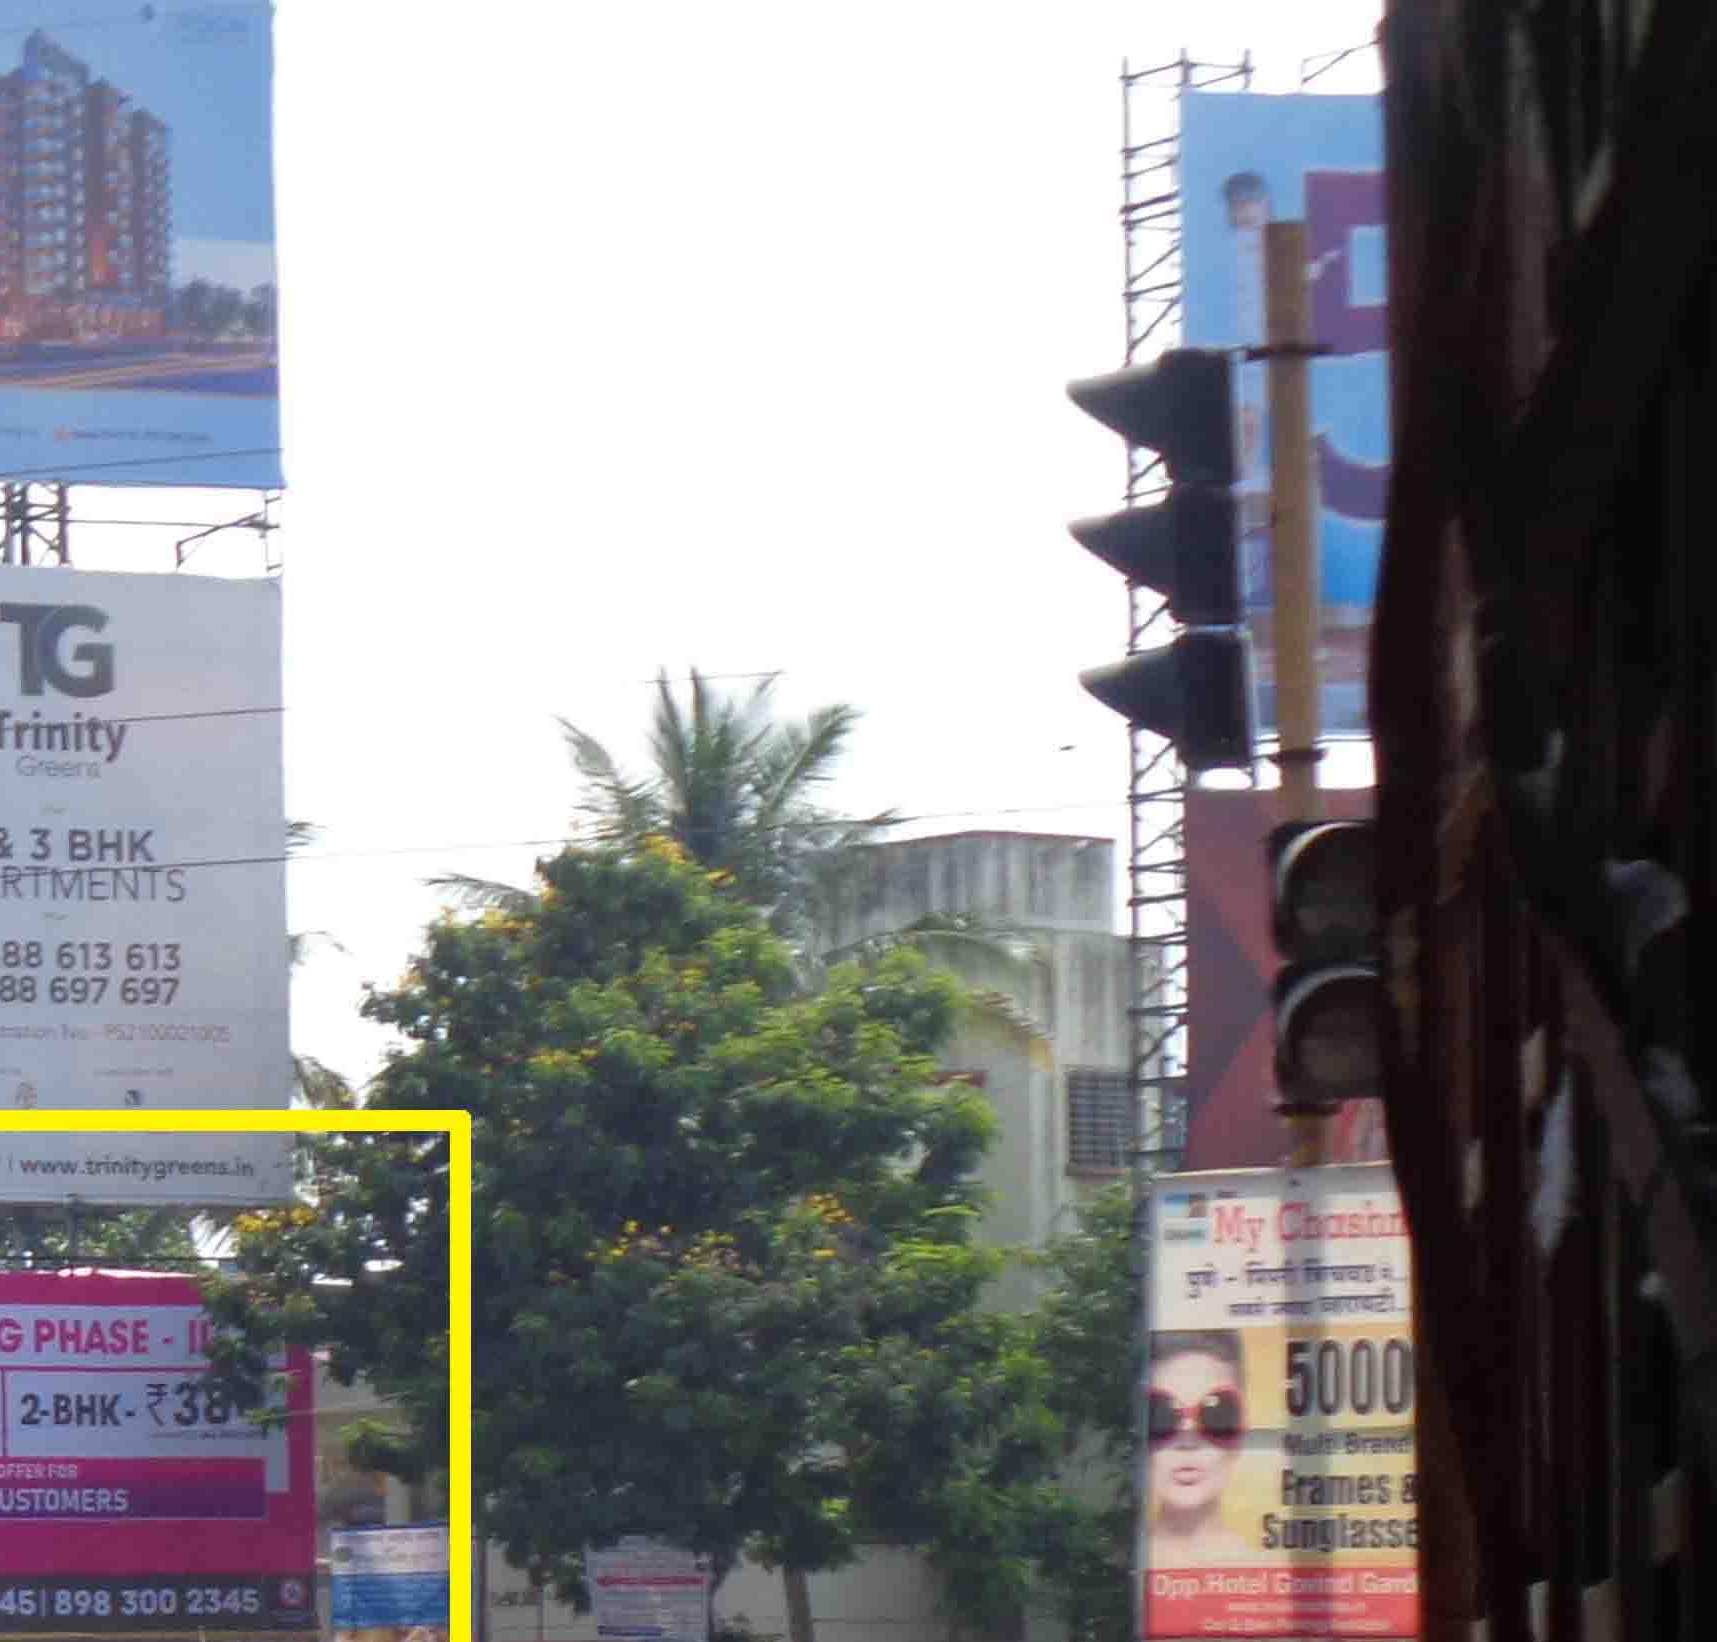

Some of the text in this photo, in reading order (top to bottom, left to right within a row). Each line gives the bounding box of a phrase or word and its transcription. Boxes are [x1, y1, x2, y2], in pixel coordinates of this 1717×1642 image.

[15, 753, 102, 780] Greens
[29, 829, 53, 863] 3
[68, 828, 156, 864] BHK
[56, 942, 114, 971] 613
[125, 943, 182, 972] 613
[49, 976, 107, 1005] 697
[119, 977, 181, 1007] 697
[19, 1156, 255, 1183] www.trinitygreens.in
[32, 1316, 150, 1356] PHASE
[47, 1463, 78, 1480] FOR
[1281, 1467, 1393, 1507] Frames
[55, 1588, 260, 1616] 898 300 2345
